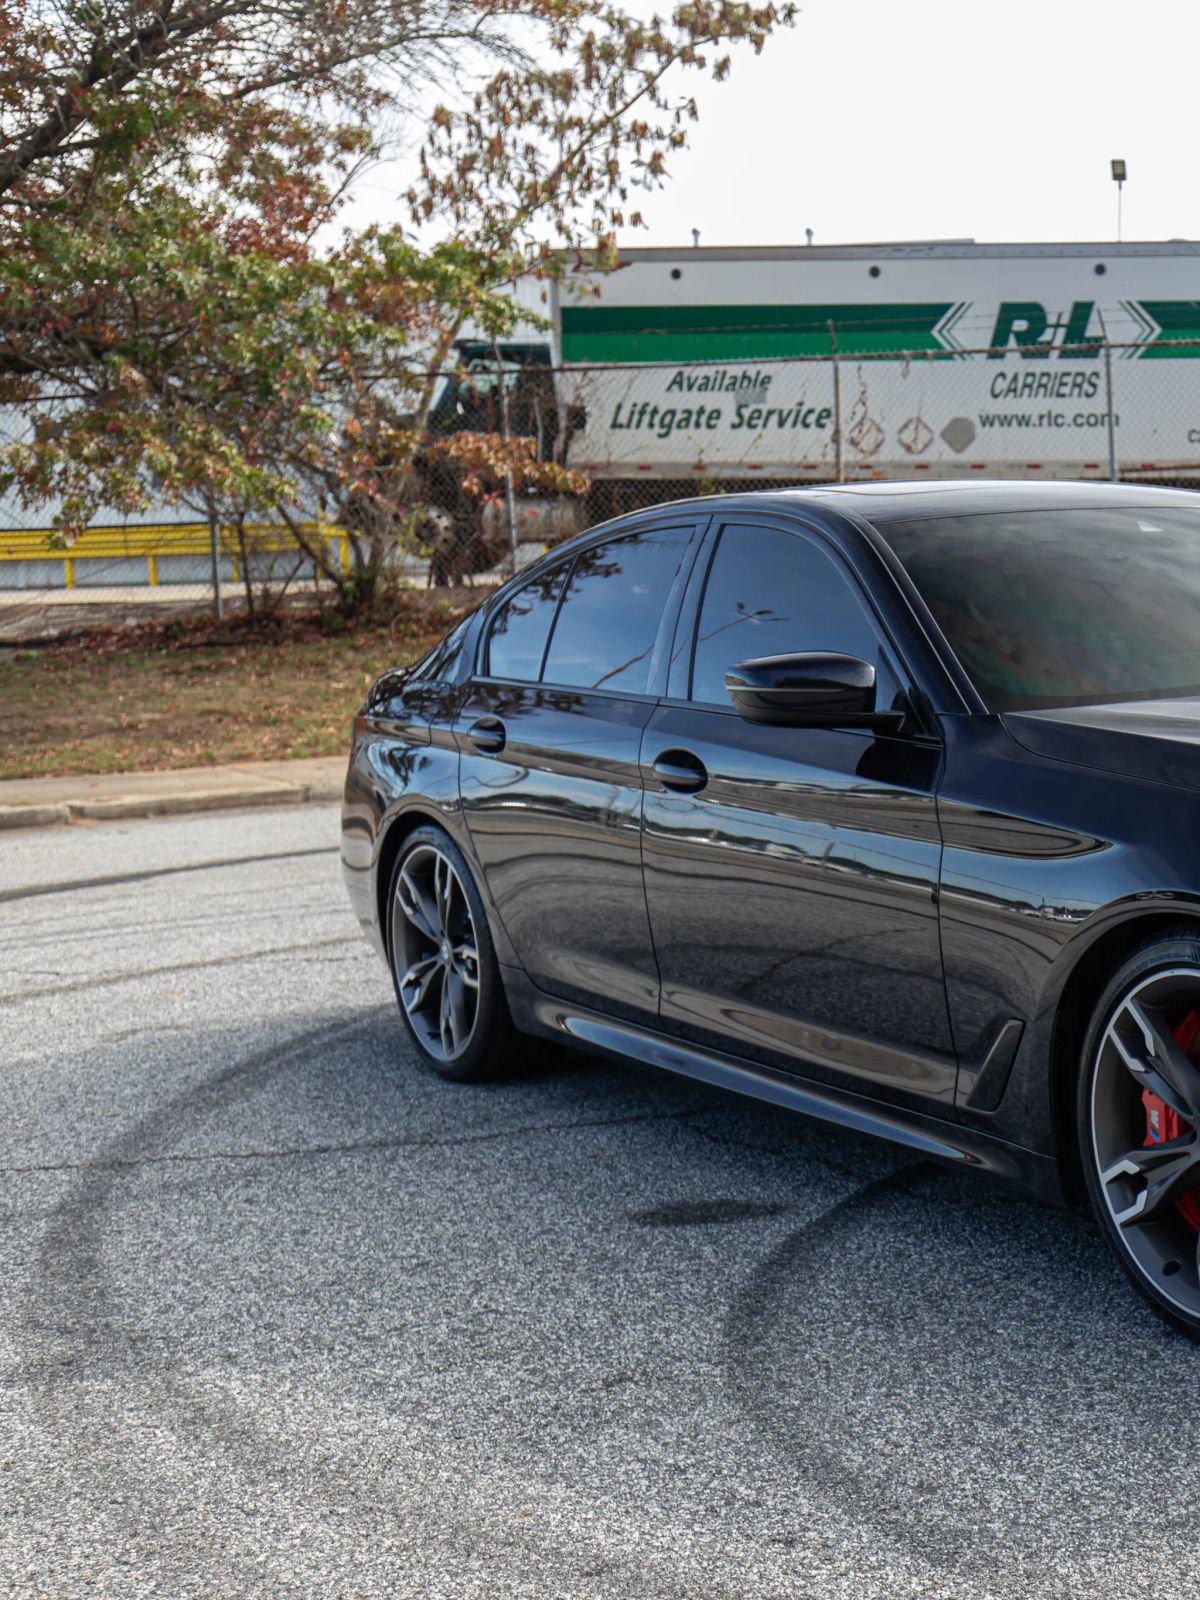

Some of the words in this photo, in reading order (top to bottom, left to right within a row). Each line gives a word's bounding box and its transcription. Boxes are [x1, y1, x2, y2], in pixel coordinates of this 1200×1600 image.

[665, 369, 772, 392] Available
[990, 371, 1100, 399] CARRIERS
[610, 402, 722, 438] Liftgate
[731, 402, 832, 430] Service
[978, 409, 1119, 428] www.rlc.com
